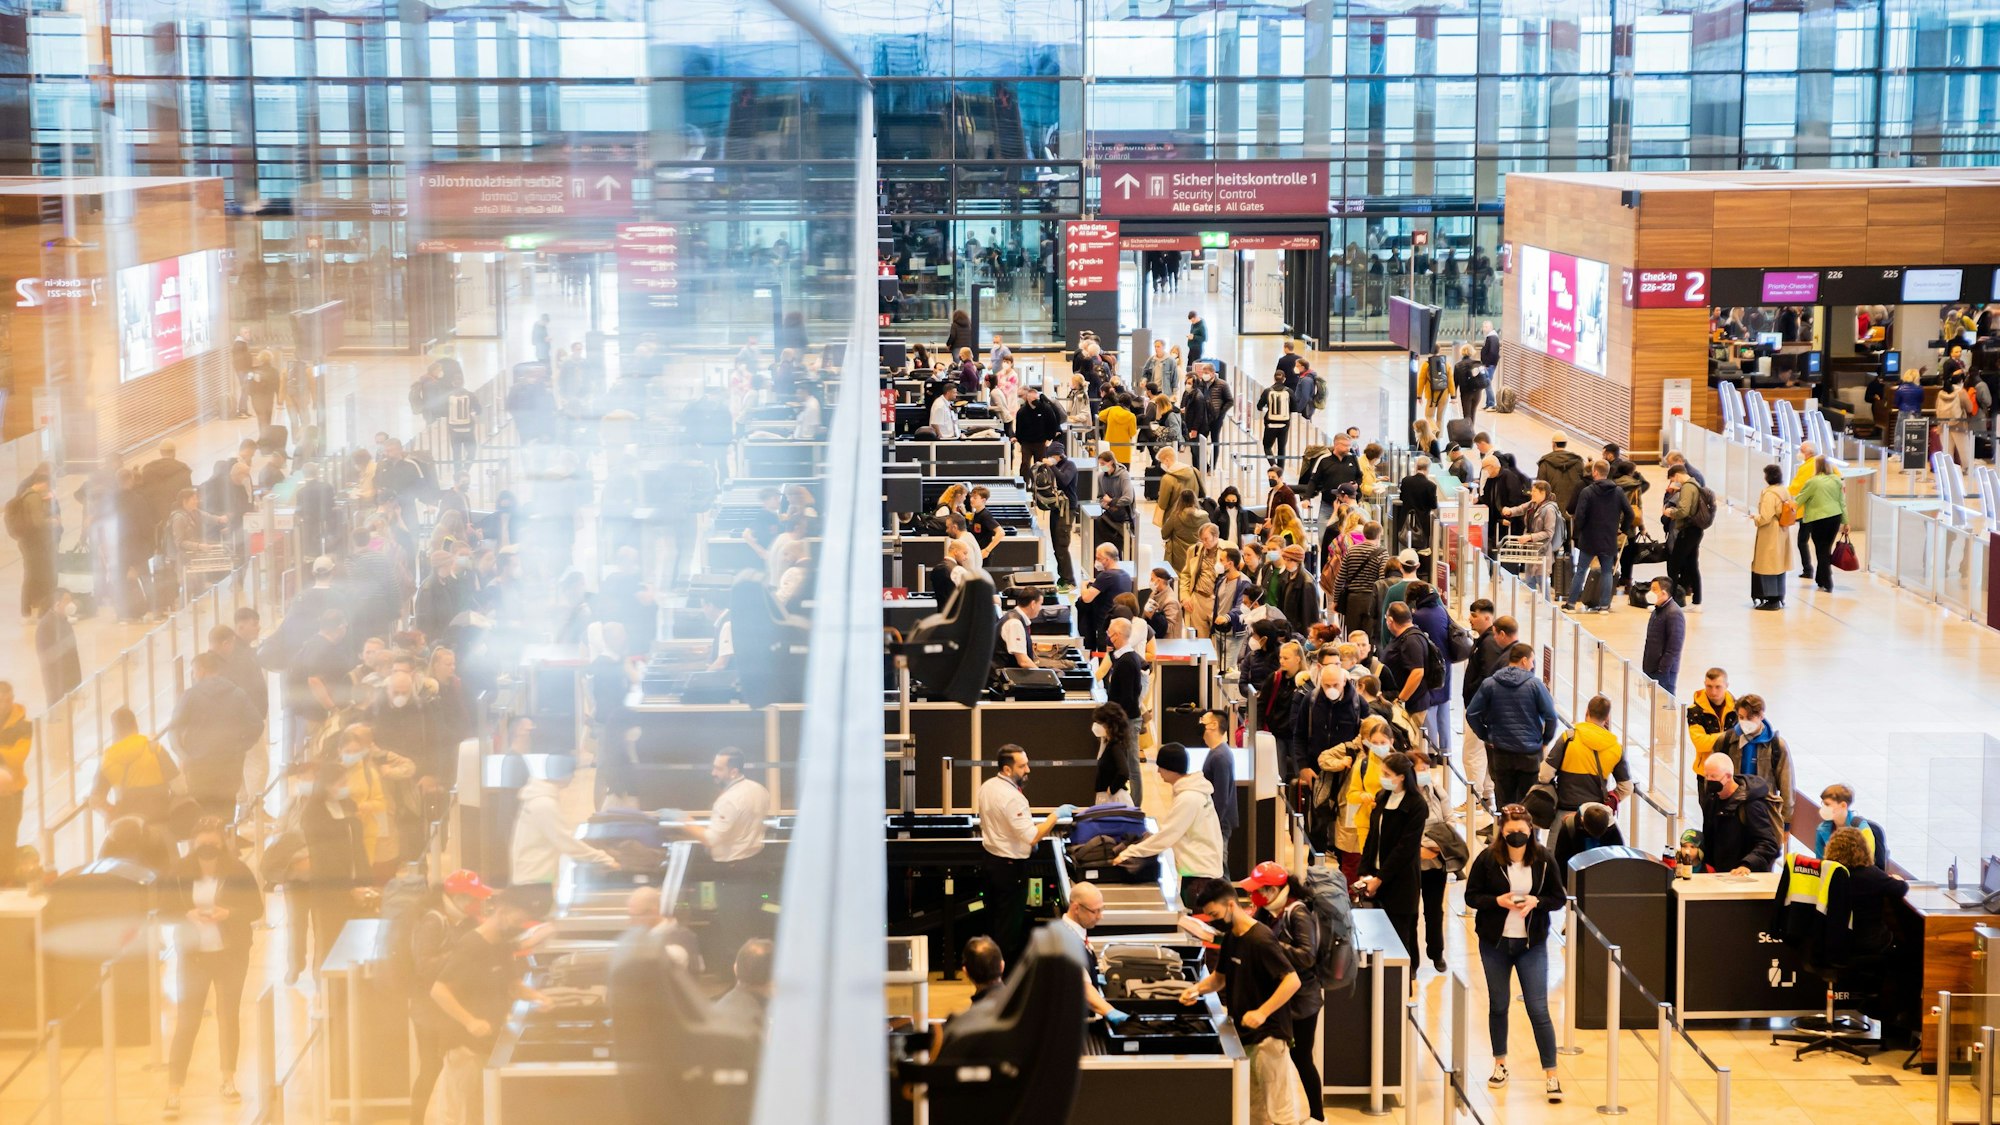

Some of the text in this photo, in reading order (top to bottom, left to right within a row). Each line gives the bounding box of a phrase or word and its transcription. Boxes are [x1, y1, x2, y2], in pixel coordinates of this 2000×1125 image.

[1173, 172, 1317, 186] Sicherheitskontrolle 1
[1172, 189, 1257, 202] Security Control
[1172, 202, 1265, 212] Alle Gates All Gates
[1641, 272, 1678, 282] Check-in
[1827, 271, 1844, 279] 226
[1883, 270, 1899, 279] 225
[1684, 271, 1706, 301] 2
